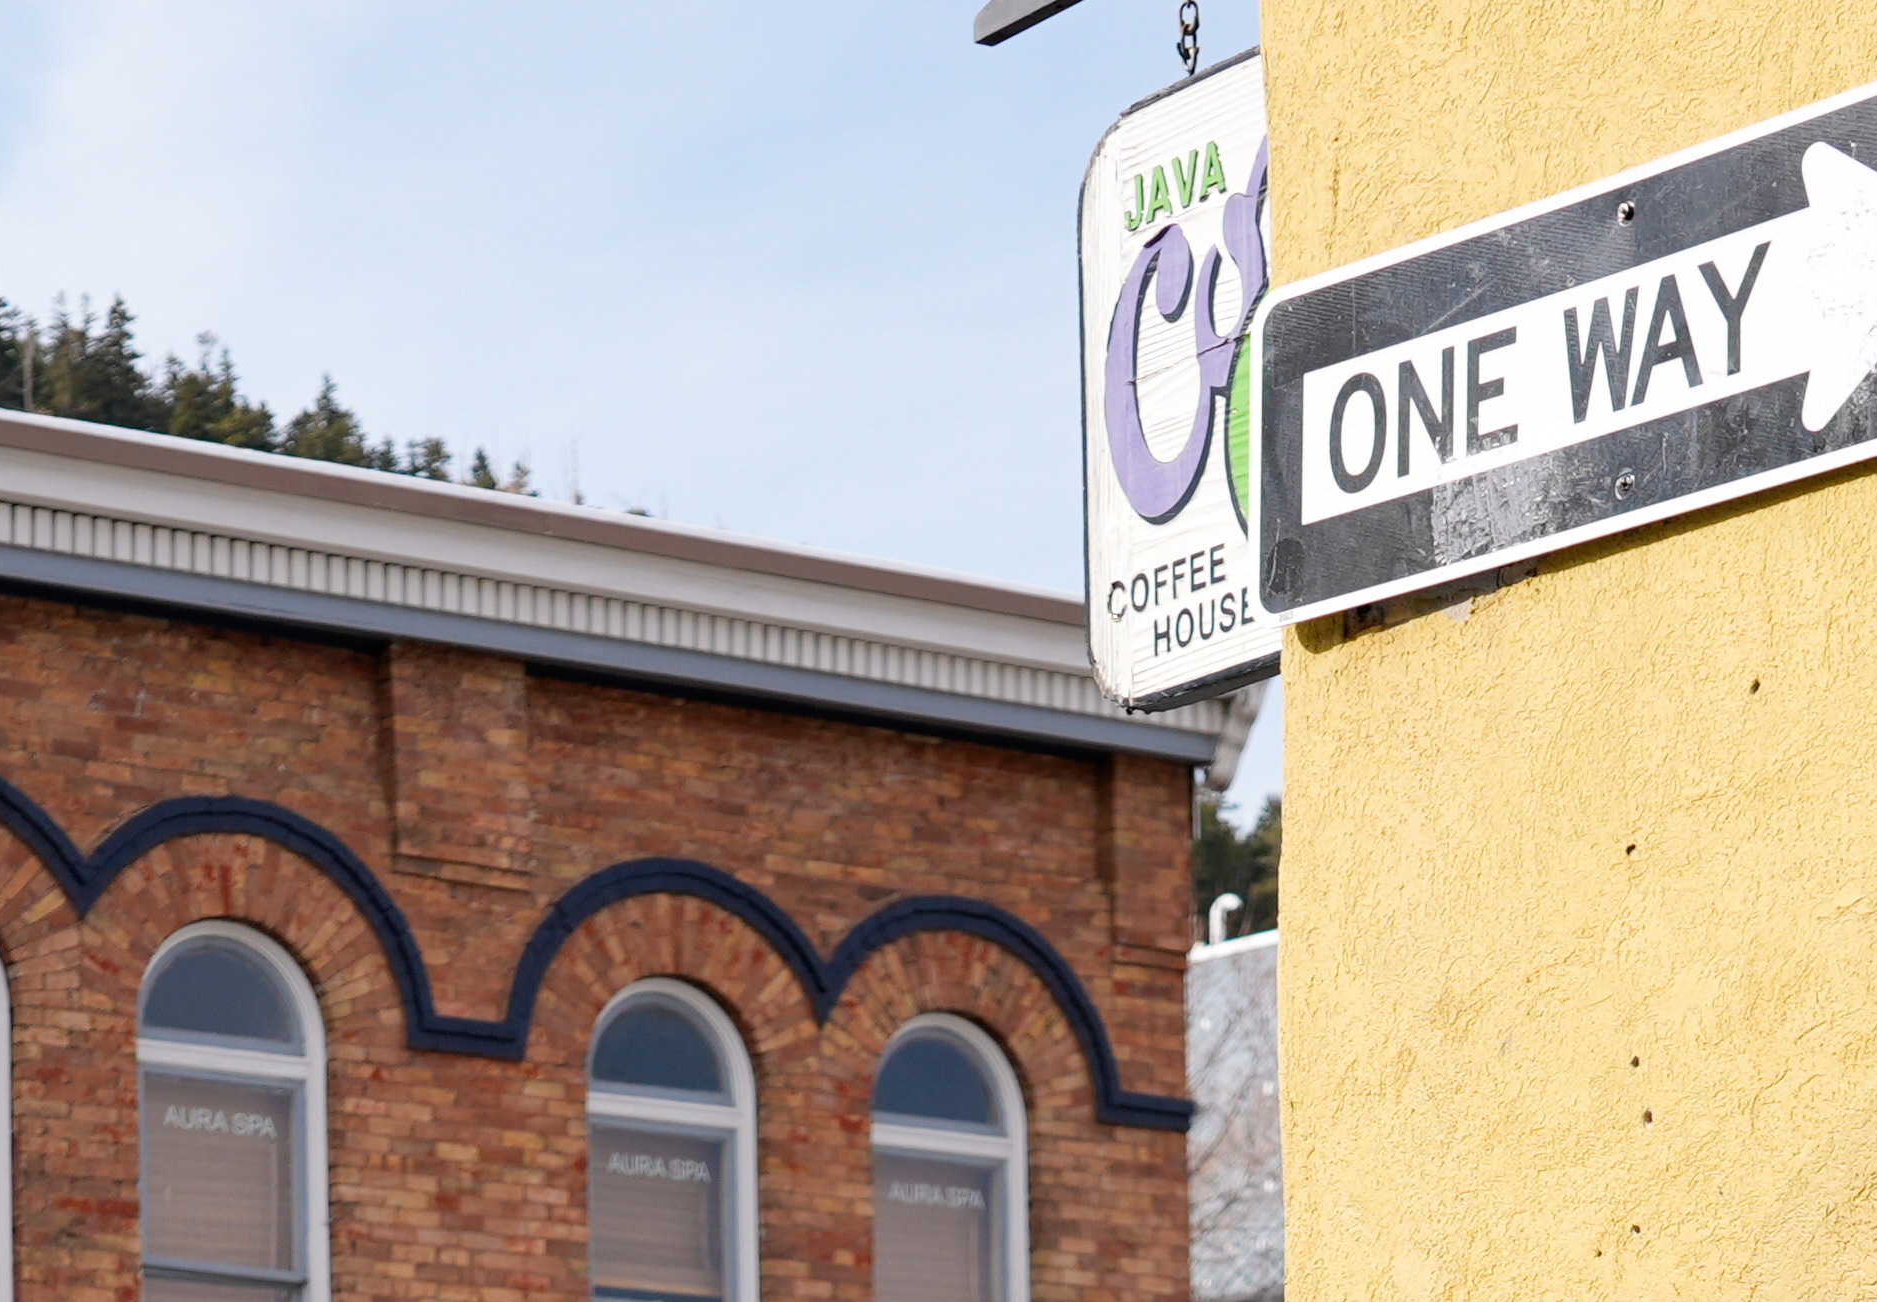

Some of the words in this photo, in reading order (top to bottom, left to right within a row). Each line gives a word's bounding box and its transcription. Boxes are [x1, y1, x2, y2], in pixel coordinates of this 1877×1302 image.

[1124, 141, 1228, 231] JAVA
[1330, 328, 1519, 495] ONE
[1563, 241, 1772, 424] WAY
[1107, 543, 1227, 622] COFFEE
[1154, 586, 1255, 658] HOUSE
[163, 1104, 230, 1132] AURA
[231, 1112, 278, 1138] SPA
[607, 1151, 668, 1178] AURA
[668, 1158, 712, 1183] SPA
